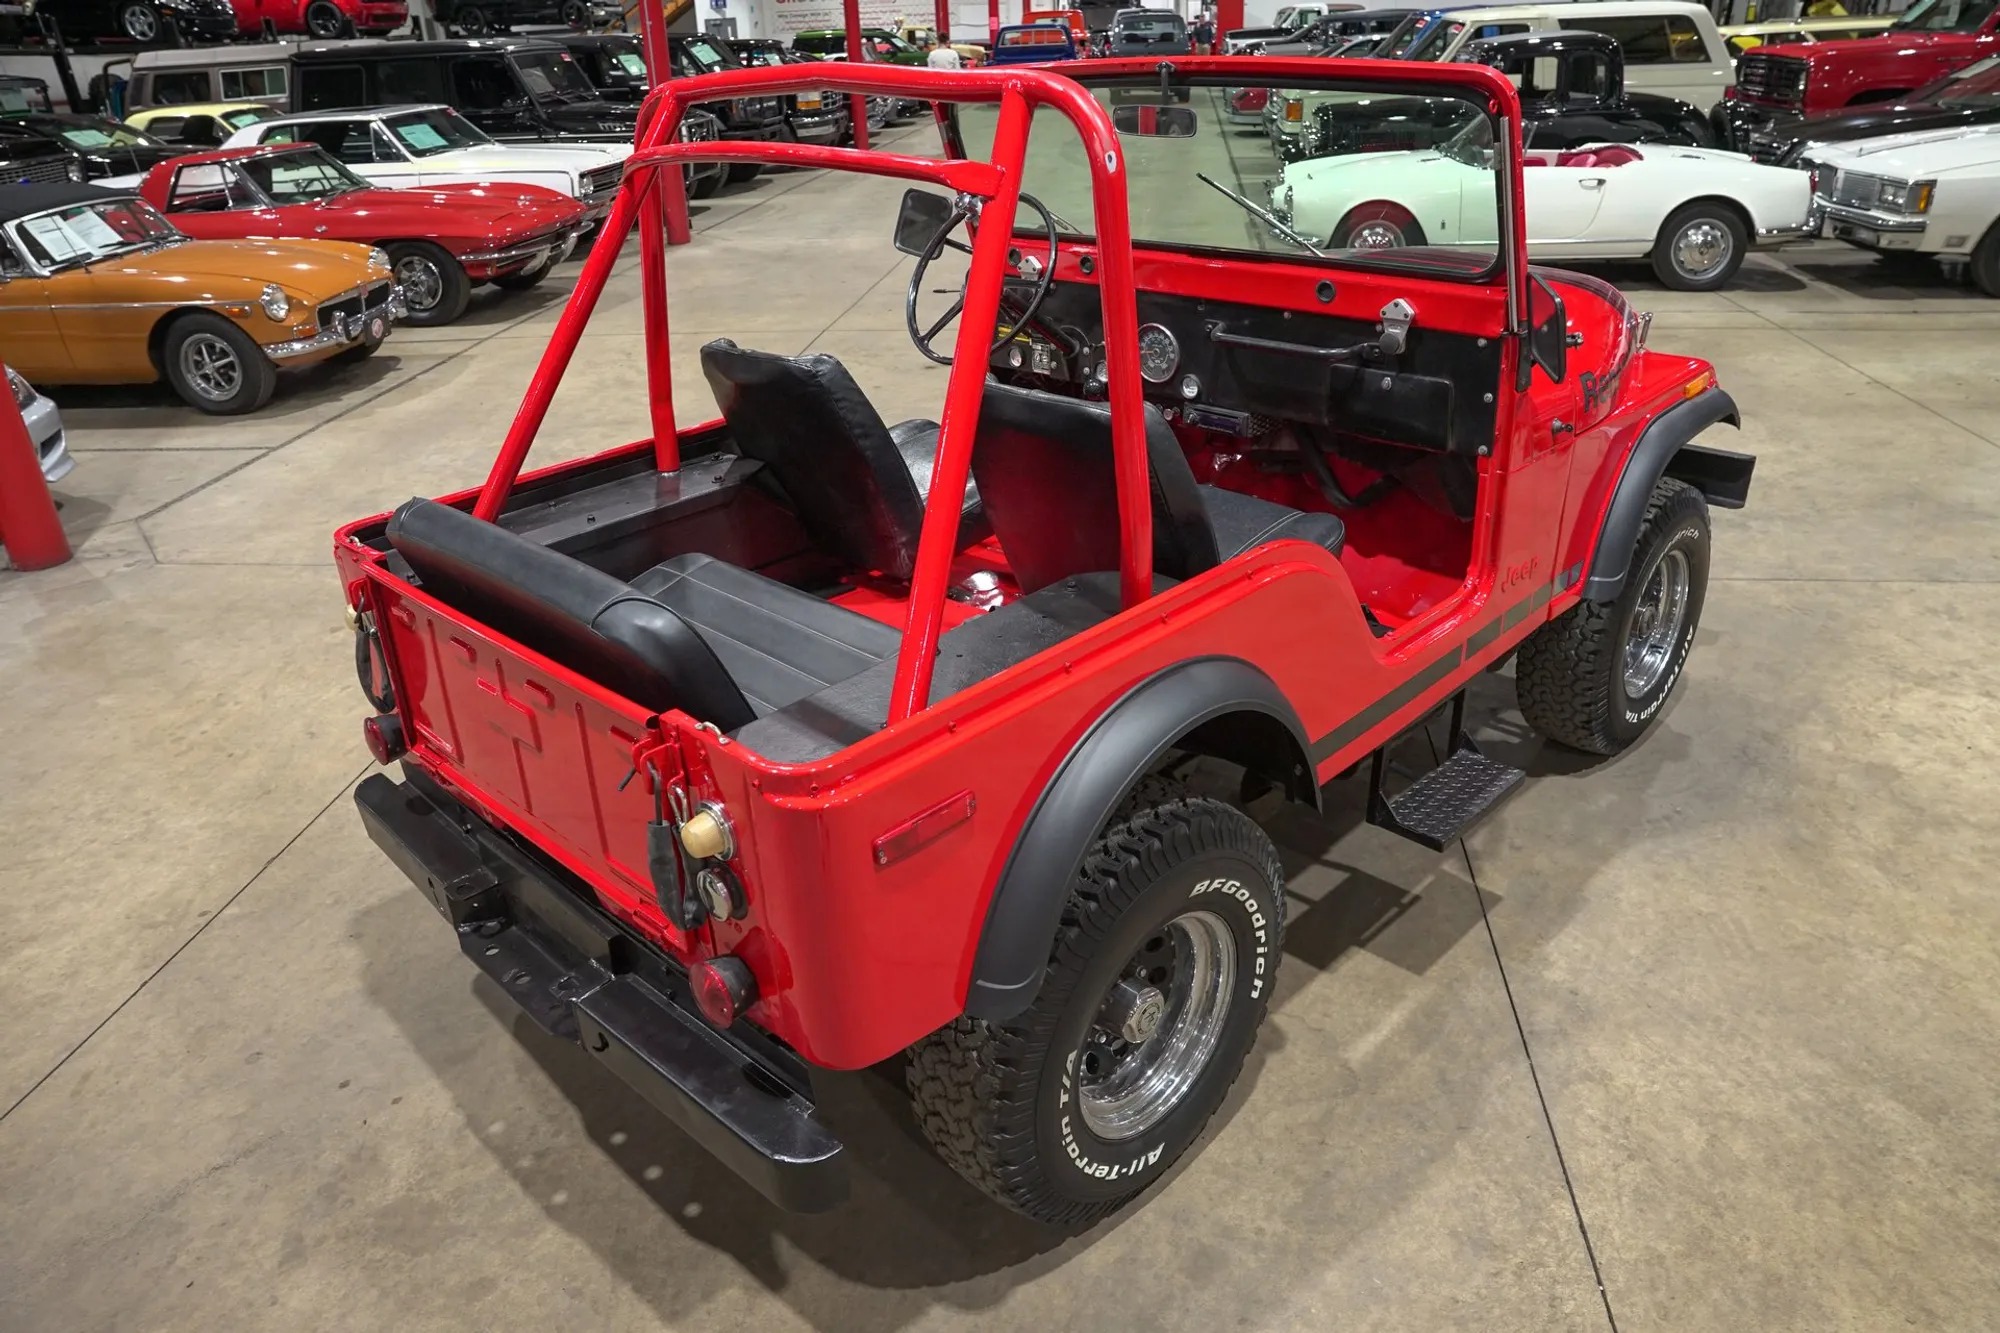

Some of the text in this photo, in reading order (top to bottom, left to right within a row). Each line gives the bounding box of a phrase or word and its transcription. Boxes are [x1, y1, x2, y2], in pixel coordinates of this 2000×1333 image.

[1188, 878, 1268, 999] BFGoodrich
[1060, 1049, 1165, 1181] All-Terrain T/A
